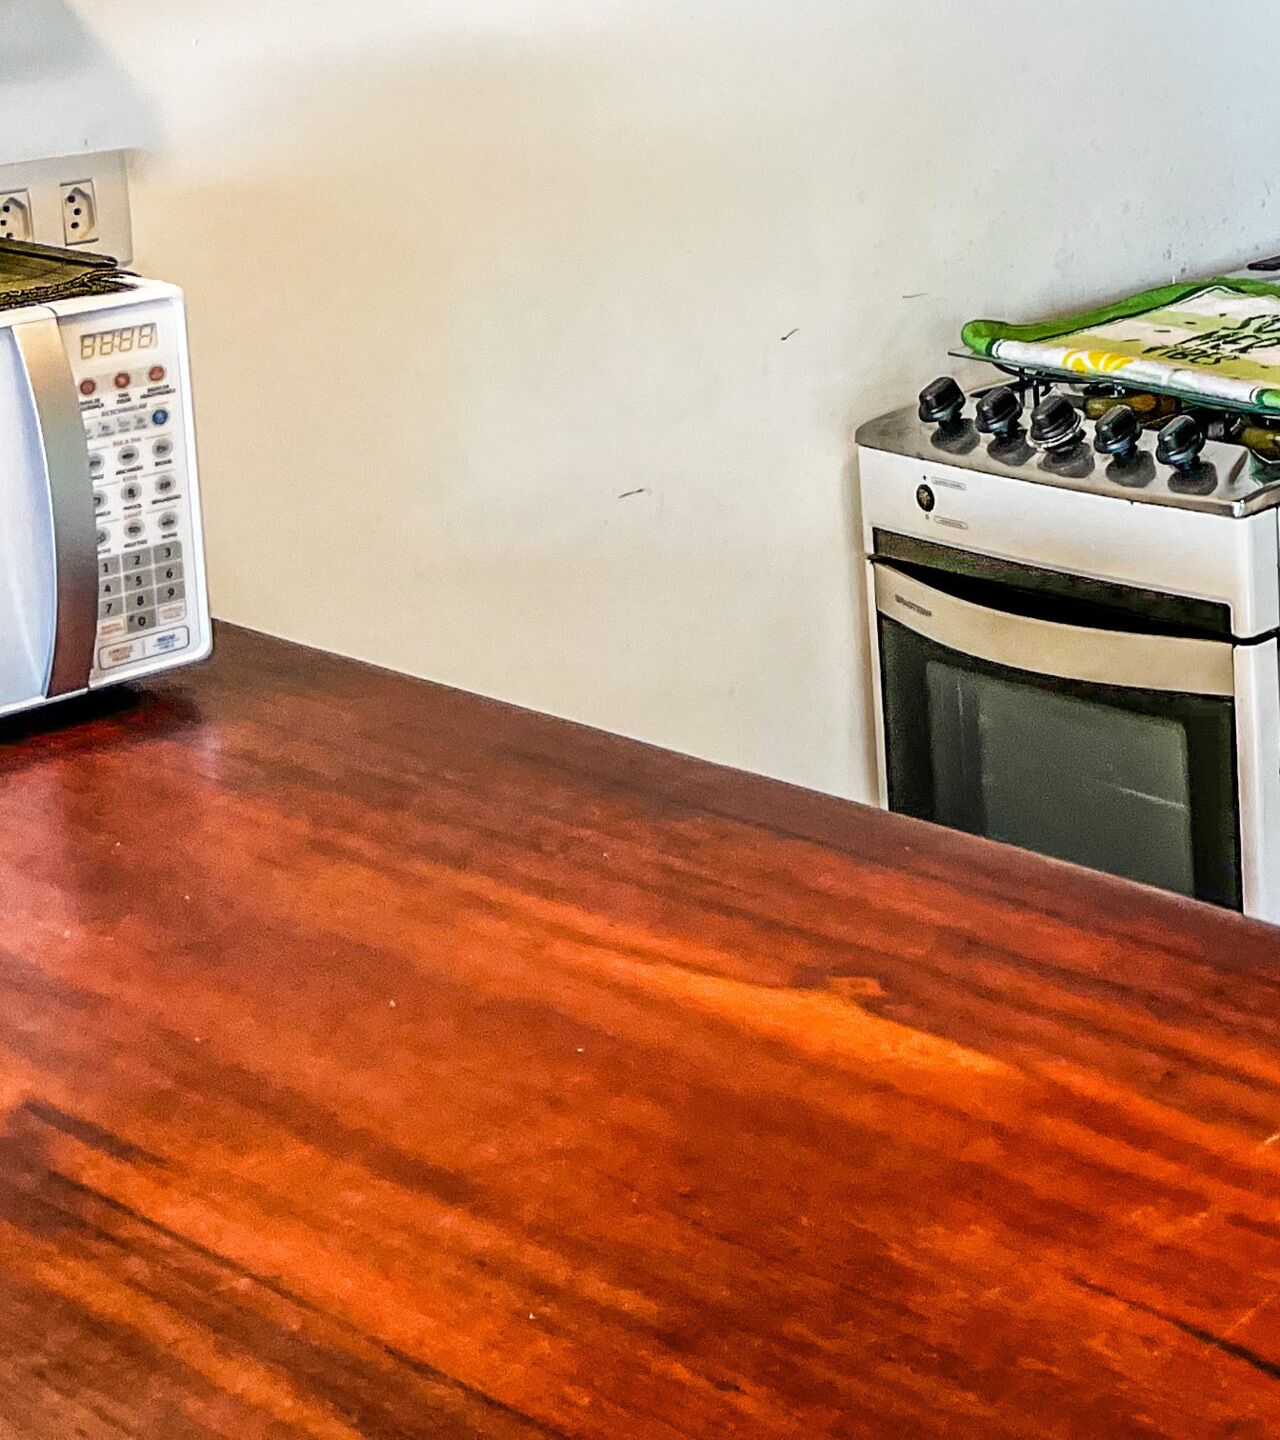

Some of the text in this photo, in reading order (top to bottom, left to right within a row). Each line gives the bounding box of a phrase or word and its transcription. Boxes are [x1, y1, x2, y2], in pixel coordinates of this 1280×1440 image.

[103, 547, 172, 573] 1 2 3
[135, 575, 142, 586] 5
[166, 568, 173, 579] 6
[106, 587, 175, 613] 7 8 9
[137, 616, 146, 626] 0
